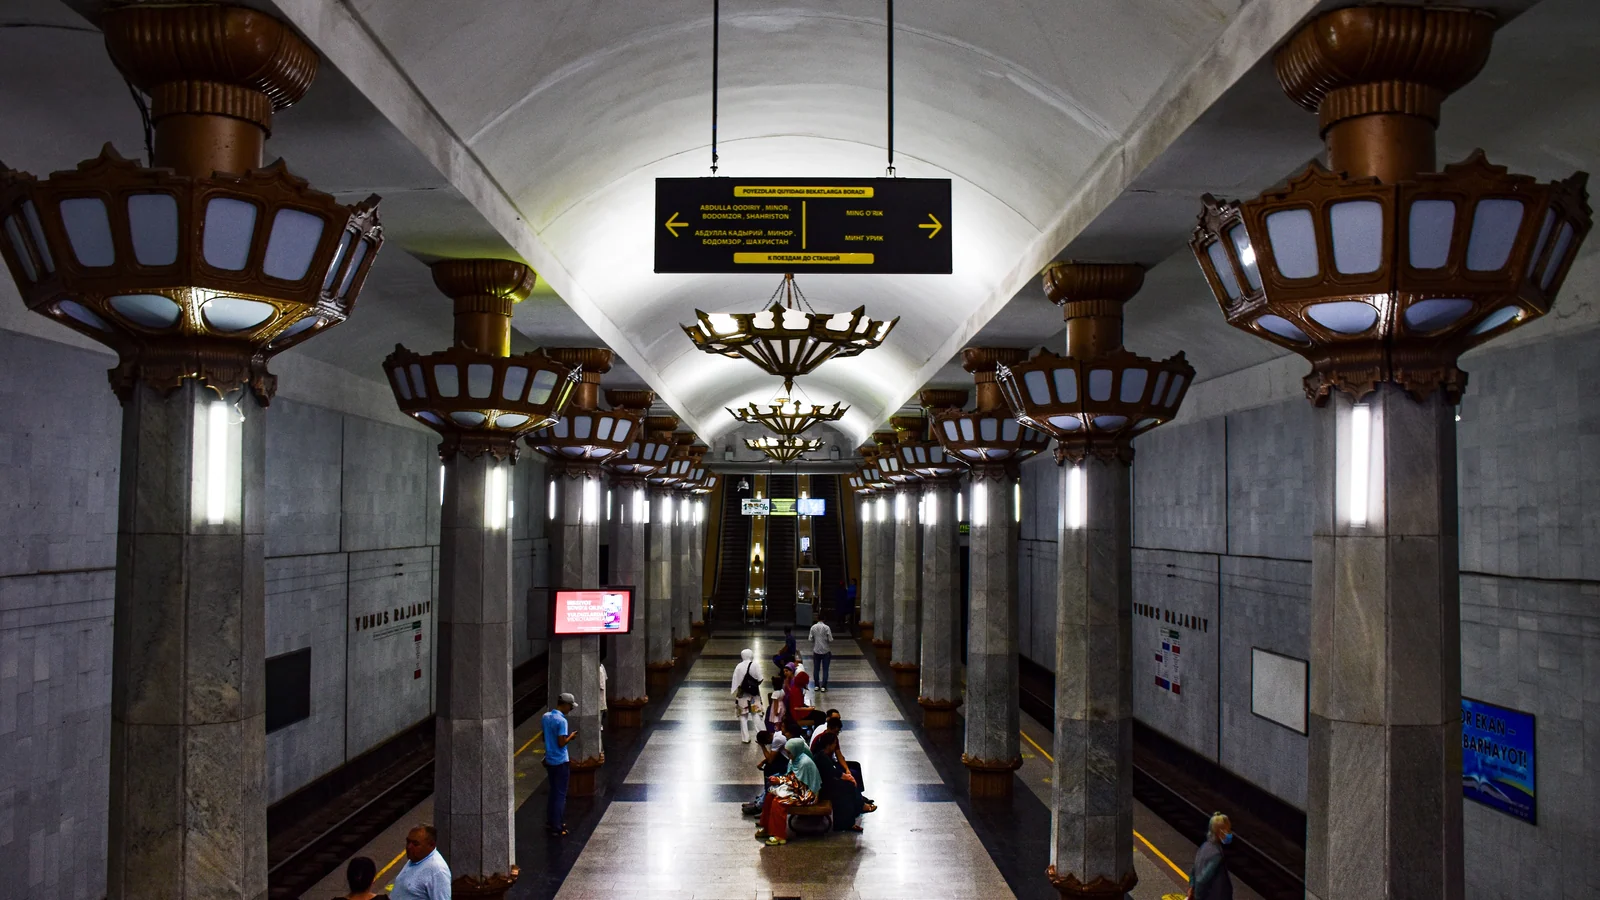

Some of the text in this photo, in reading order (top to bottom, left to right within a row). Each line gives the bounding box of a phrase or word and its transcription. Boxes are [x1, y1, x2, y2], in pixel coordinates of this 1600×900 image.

[812, 254, 841, 262] СТАНЦИЙ
[355, 611, 389, 632] YUNUS
[393, 600, 430, 622] RAJABIY
[1133, 602, 1160, 620] YUNUS
[1164, 609, 1209, 633] RAJABIY
[1475, 713, 1505, 735] EKAN
[1463, 733, 1527, 768] BARHAYOT!
